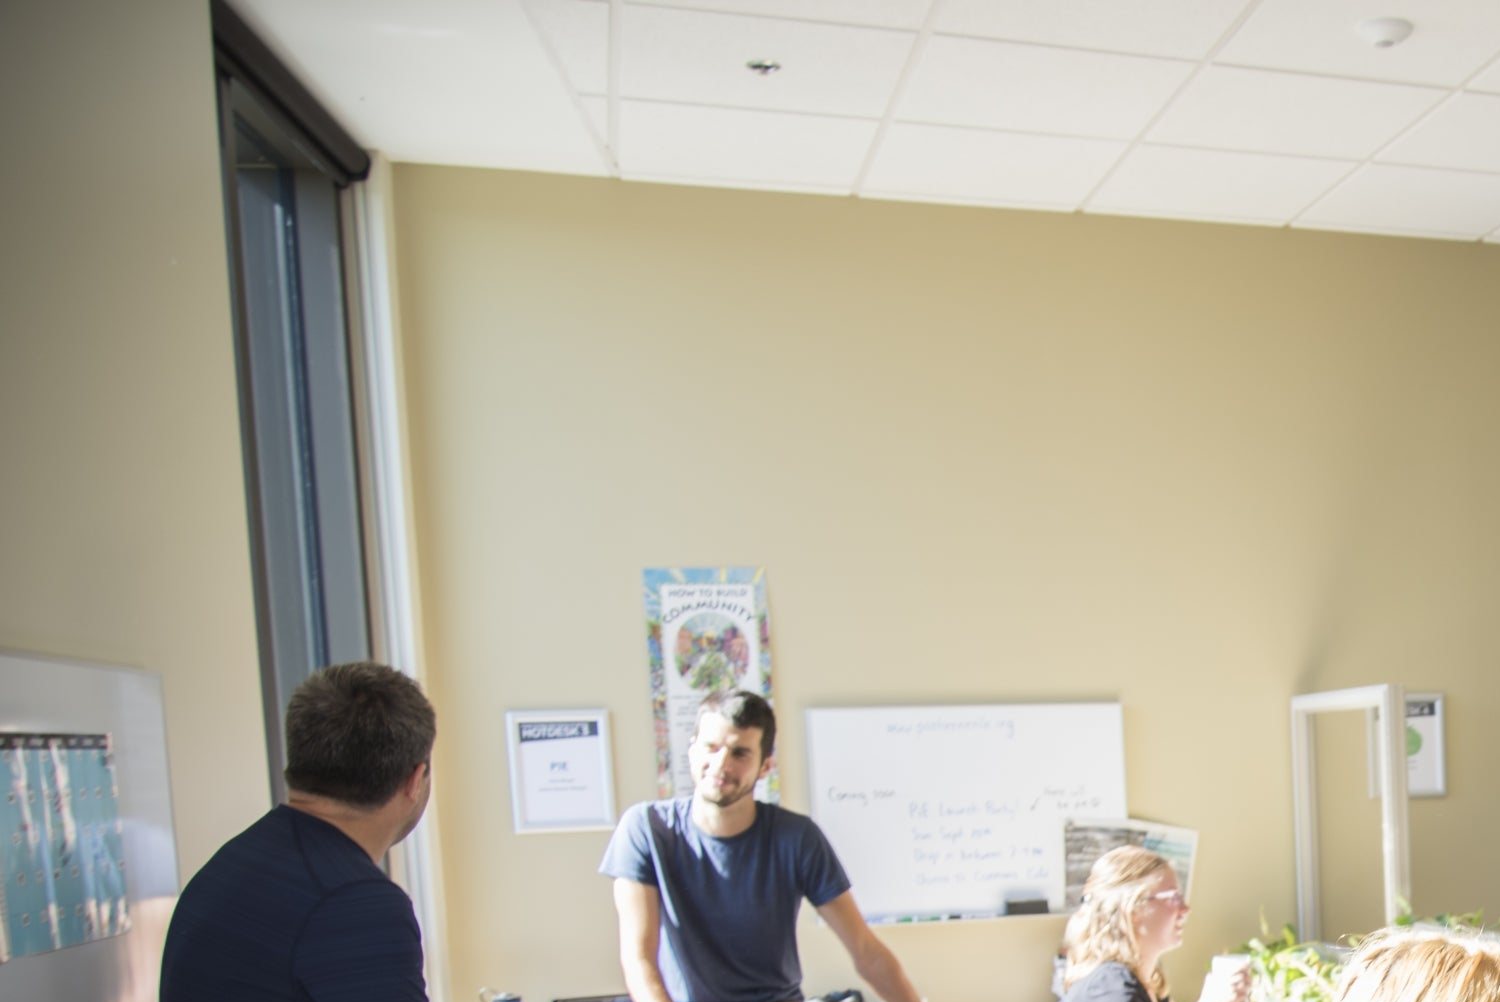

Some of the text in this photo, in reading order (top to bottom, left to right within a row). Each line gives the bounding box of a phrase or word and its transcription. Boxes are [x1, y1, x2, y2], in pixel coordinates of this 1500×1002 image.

[668, 588, 747, 598] HOW TO BUILD
[662, 601, 754, 624] COMMUNITY
[828, 785, 869, 808] Coming
